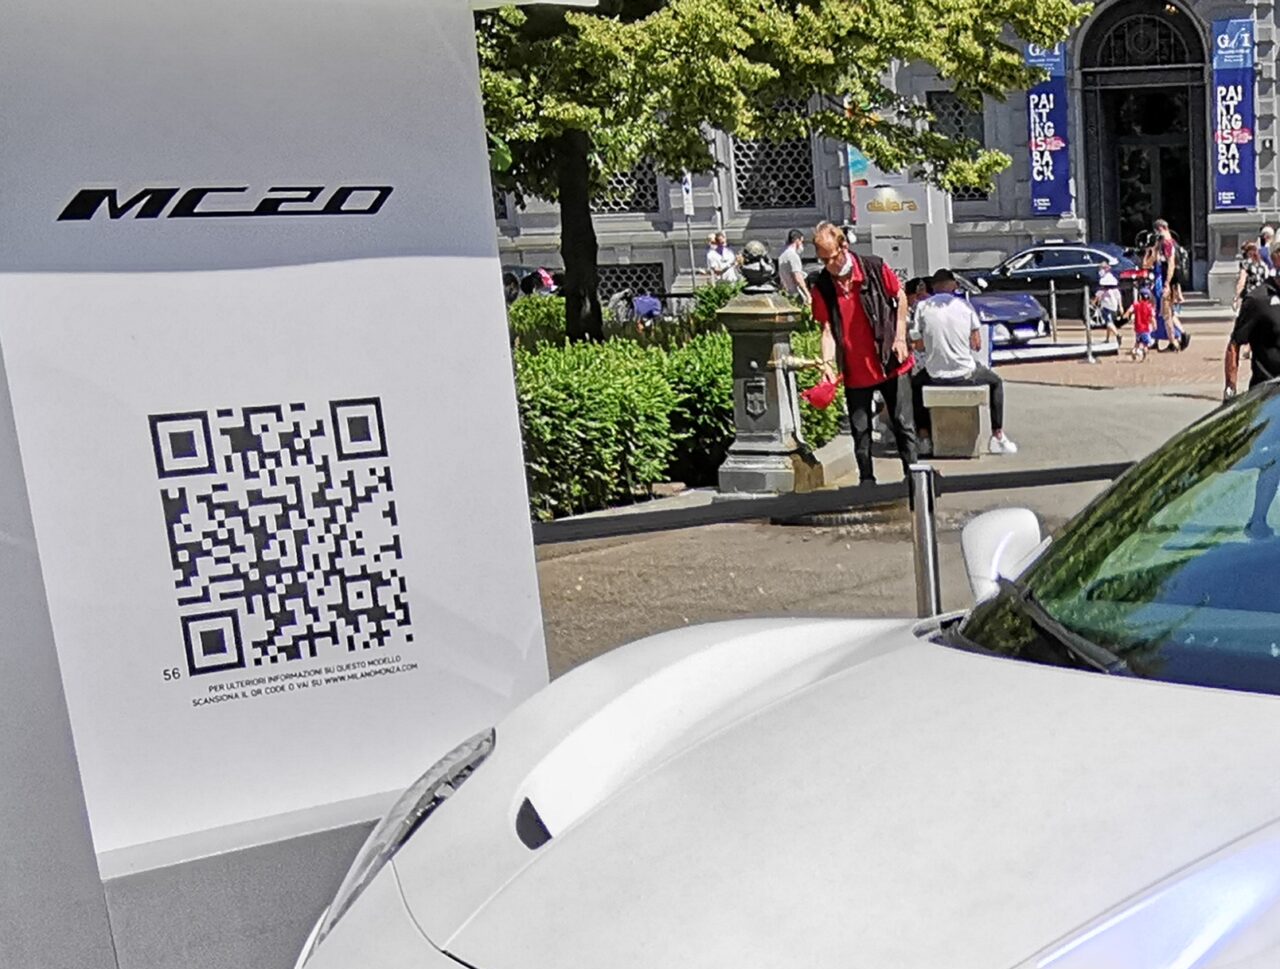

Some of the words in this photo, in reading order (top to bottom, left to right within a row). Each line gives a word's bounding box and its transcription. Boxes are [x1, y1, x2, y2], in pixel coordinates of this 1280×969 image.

[57, 186, 394, 221] MC20
[163, 667, 181, 681] 56
[192, 693, 239, 707] SCANSIONA
[250, 689, 262, 697] QR
[264, 684, 286, 695] CODE
[288, 683, 295, 691] O
[296, 681, 310, 689] VAI
[311, 679, 323, 688] SU
[324, 663, 418, 685] WWW.MILANOMONZA.COM
[208, 683, 225, 693] PER
[226, 676, 267, 690] ULTERIORI
[267, 669, 322, 682] INFORMAZIONI
[324, 666, 335, 674] SU
[336, 661, 366, 673] QUESTO
[367, 655, 402, 667] MODELLO
